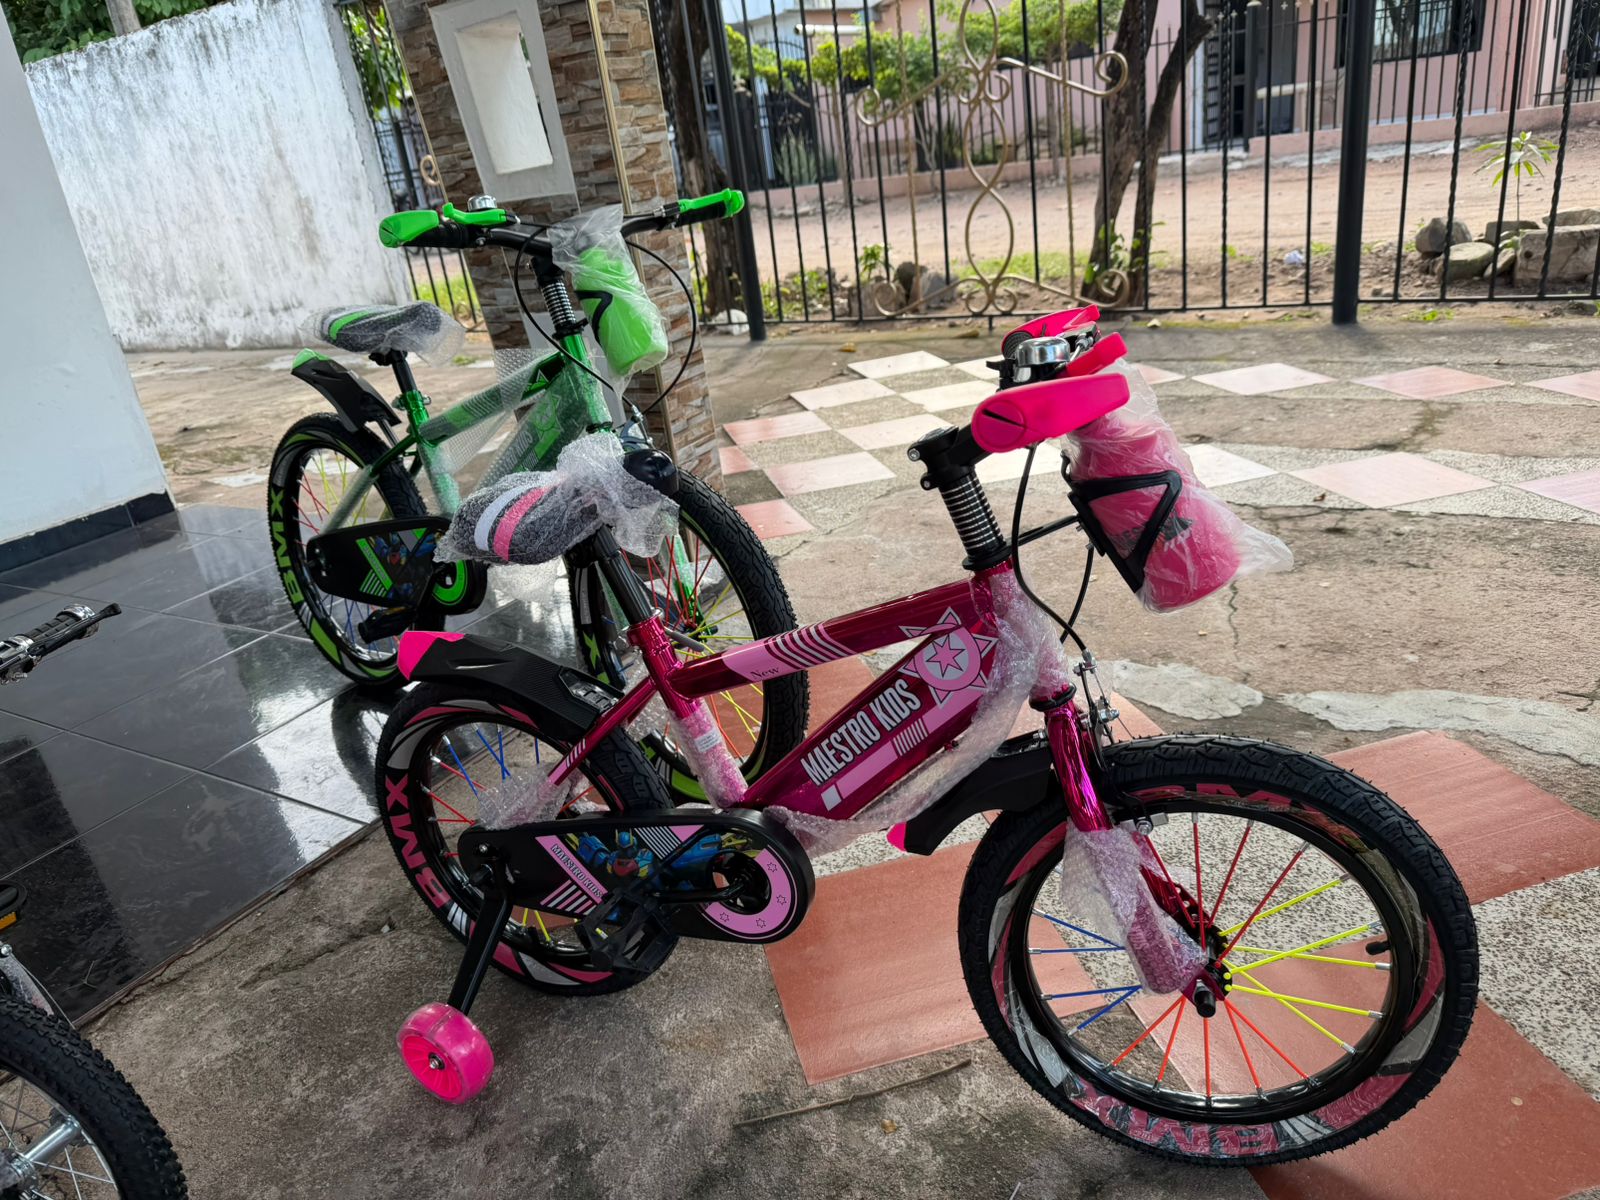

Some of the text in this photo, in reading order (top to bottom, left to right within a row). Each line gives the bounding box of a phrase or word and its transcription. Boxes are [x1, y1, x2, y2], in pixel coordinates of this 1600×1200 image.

[270, 486, 305, 605] BMX
[750, 667, 779, 680] New
[800, 678, 922, 786] MAESTRO KIDS
[384, 773, 451, 909] BMX
[550, 843, 604, 898] MAESTRO KIDS
